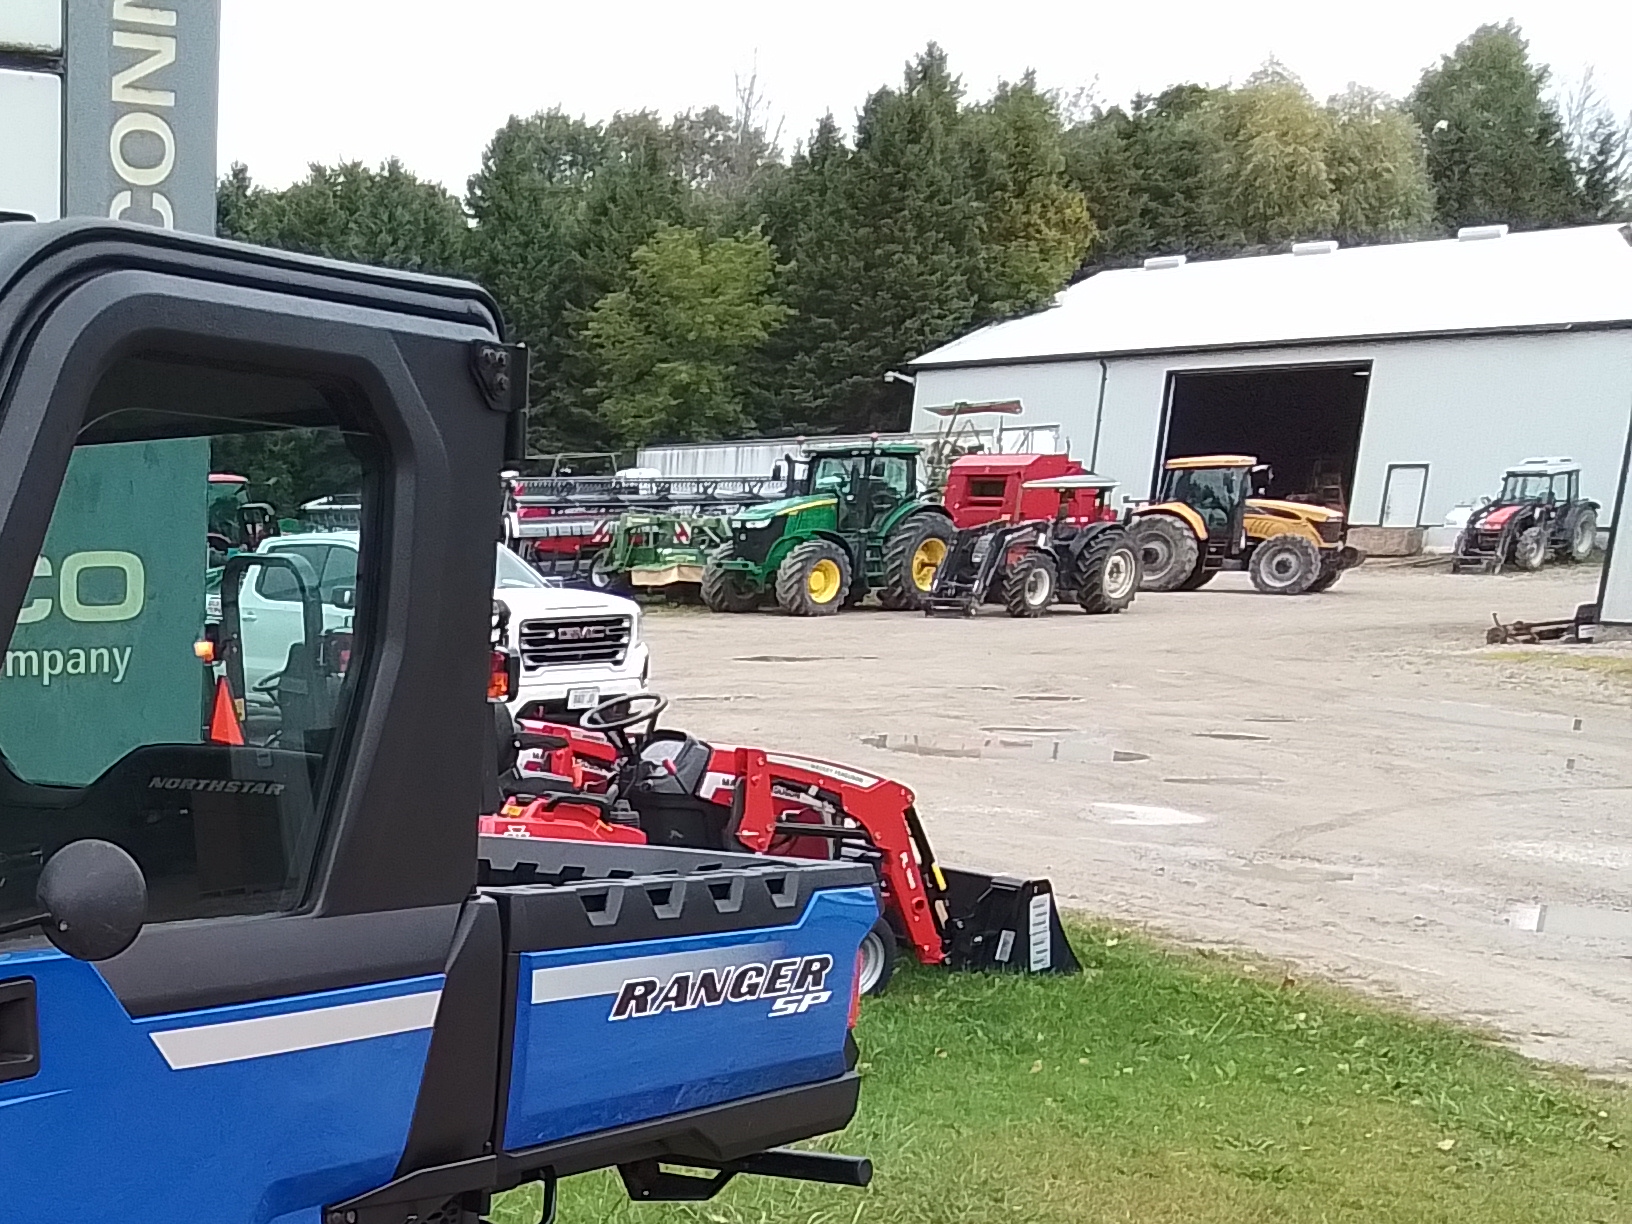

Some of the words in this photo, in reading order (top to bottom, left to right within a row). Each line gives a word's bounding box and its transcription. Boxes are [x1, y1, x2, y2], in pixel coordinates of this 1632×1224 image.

[557, 626, 606, 640] GMC
[147, 776, 286, 796] NORTHSTAR
[608, 953, 834, 1022] RANGER
[767, 990, 833, 1018] SP
